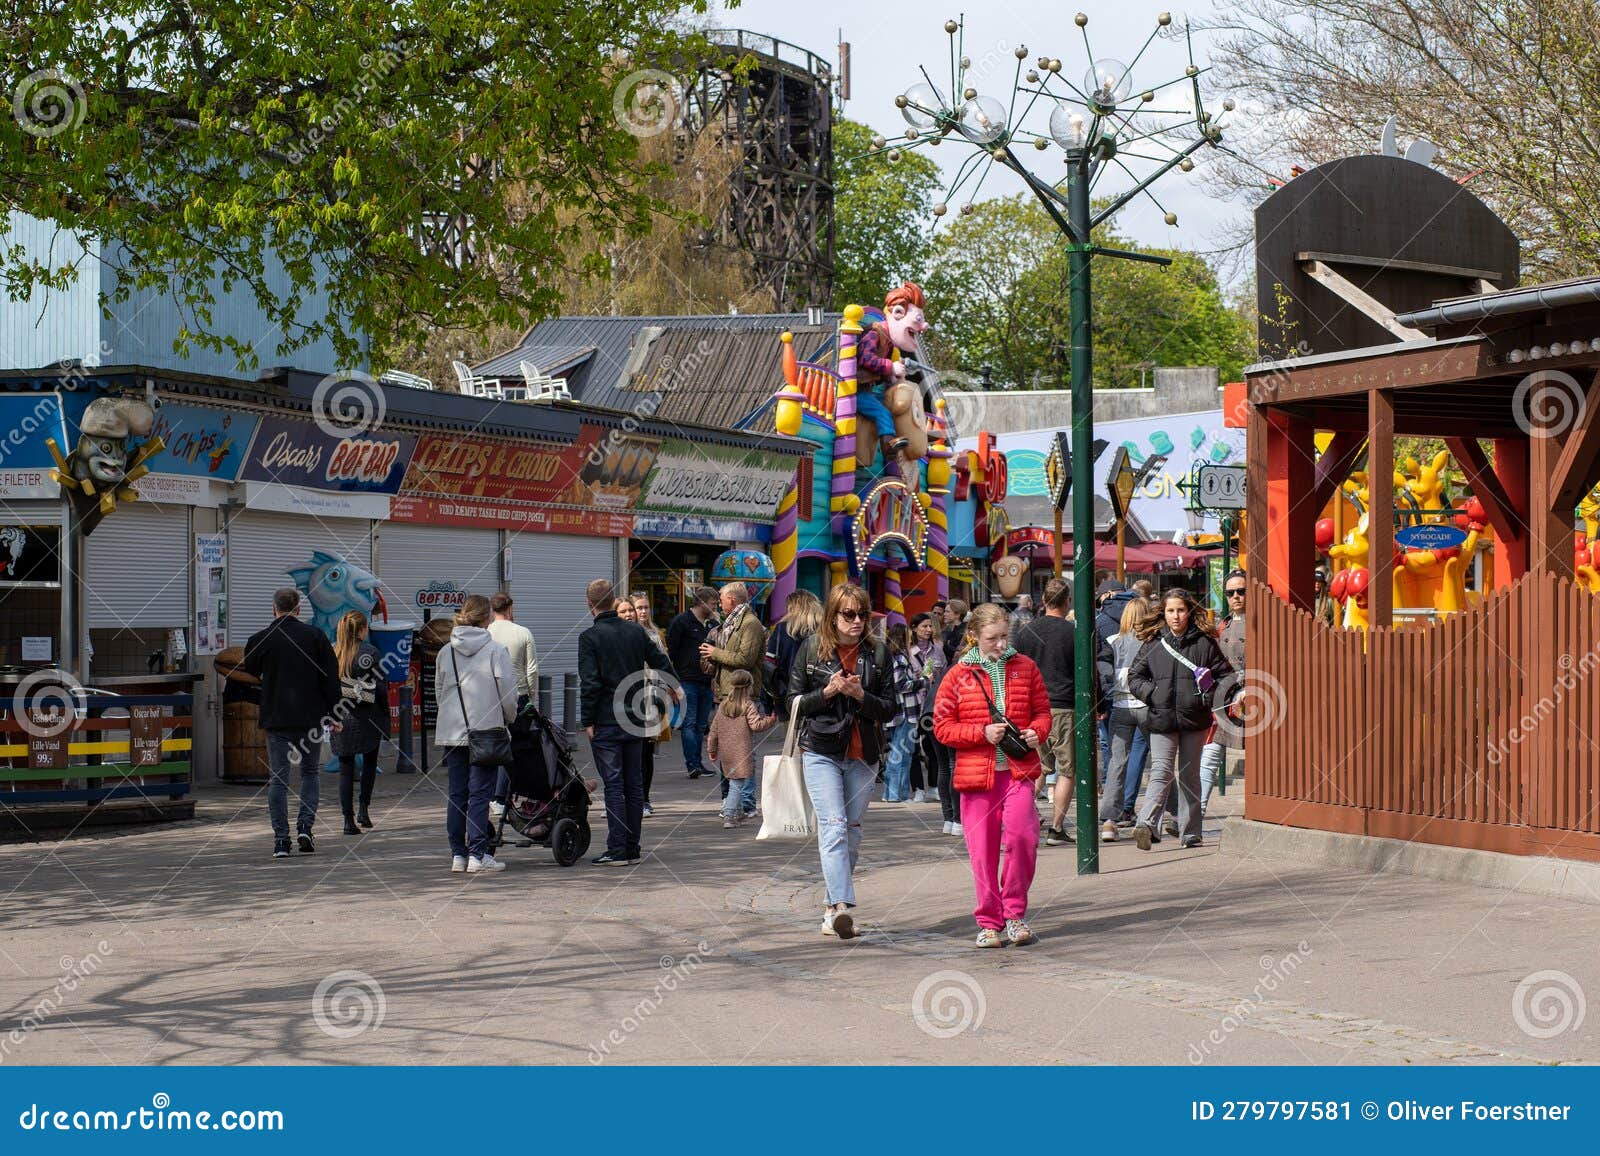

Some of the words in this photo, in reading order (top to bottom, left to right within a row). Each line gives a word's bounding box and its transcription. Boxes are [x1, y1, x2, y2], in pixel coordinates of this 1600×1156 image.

[262, 431, 323, 474] Oscars
[327, 442, 371, 479] BØF
[364, 443, 398, 480] BAR
[418, 439, 492, 478] CHIPS
[489, 447, 506, 477] &
[505, 450, 561, 483] CHOKO
[4, 474, 41, 486] FILETER
[418, 592, 441, 604] BØF
[443, 592, 464, 604] BAR
